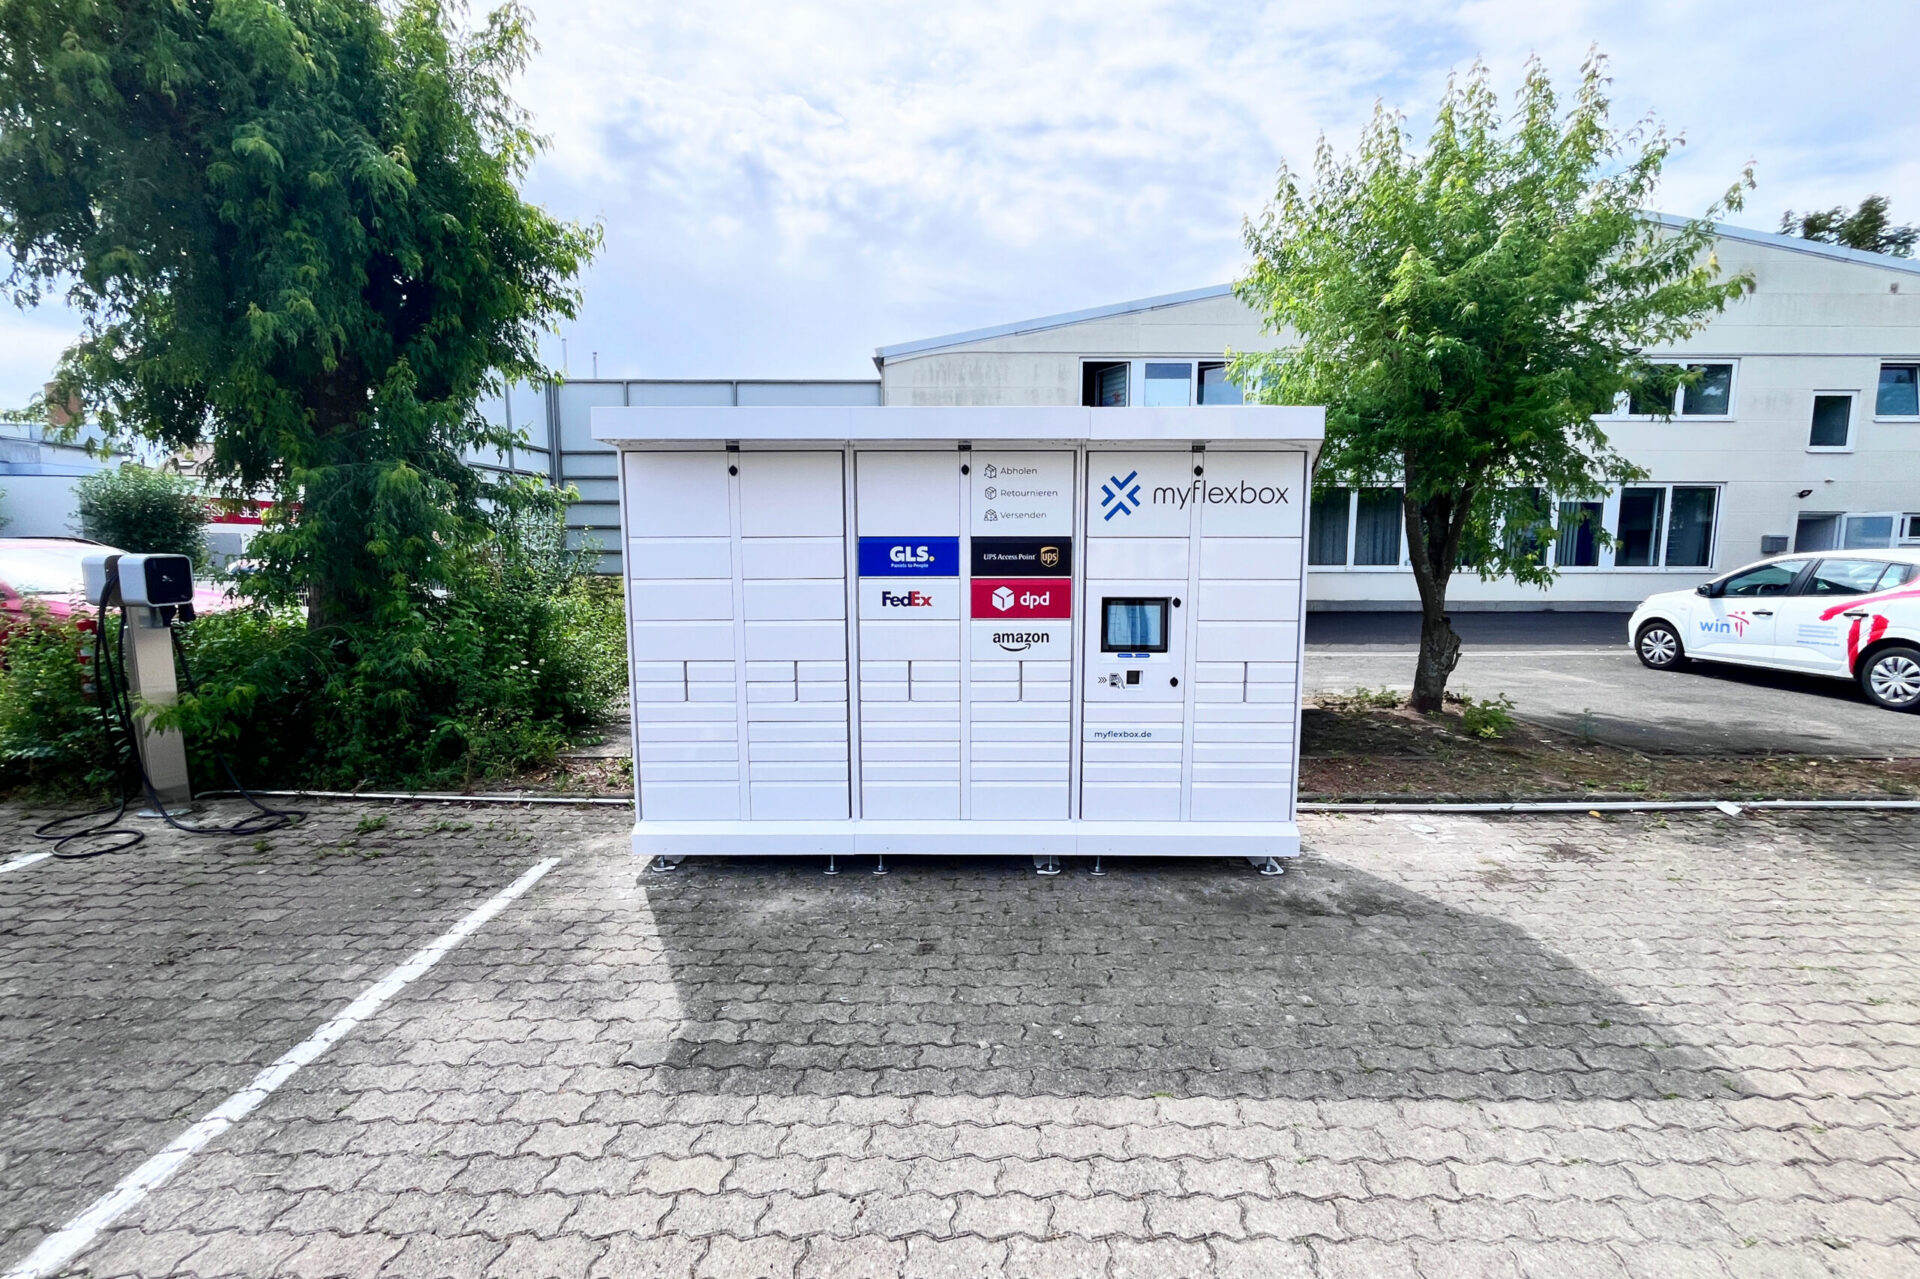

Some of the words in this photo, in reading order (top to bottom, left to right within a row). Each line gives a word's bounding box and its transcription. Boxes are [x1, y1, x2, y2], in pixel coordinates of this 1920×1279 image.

[1000, 467, 1038, 475] Abholen
[1000, 489, 1058, 497] Retournieren
[1153, 480, 1289, 510] myflexbox
[1000, 511, 1047, 519] Versenden
[1042, 553, 1057, 564] ups
[882, 591, 933, 607] FedEx
[1020, 591, 1050, 609] dpd
[1699, 618, 1730, 633] win
[992, 632, 1050, 644] amazon
[1094, 730, 1152, 739] myflexbox.de
